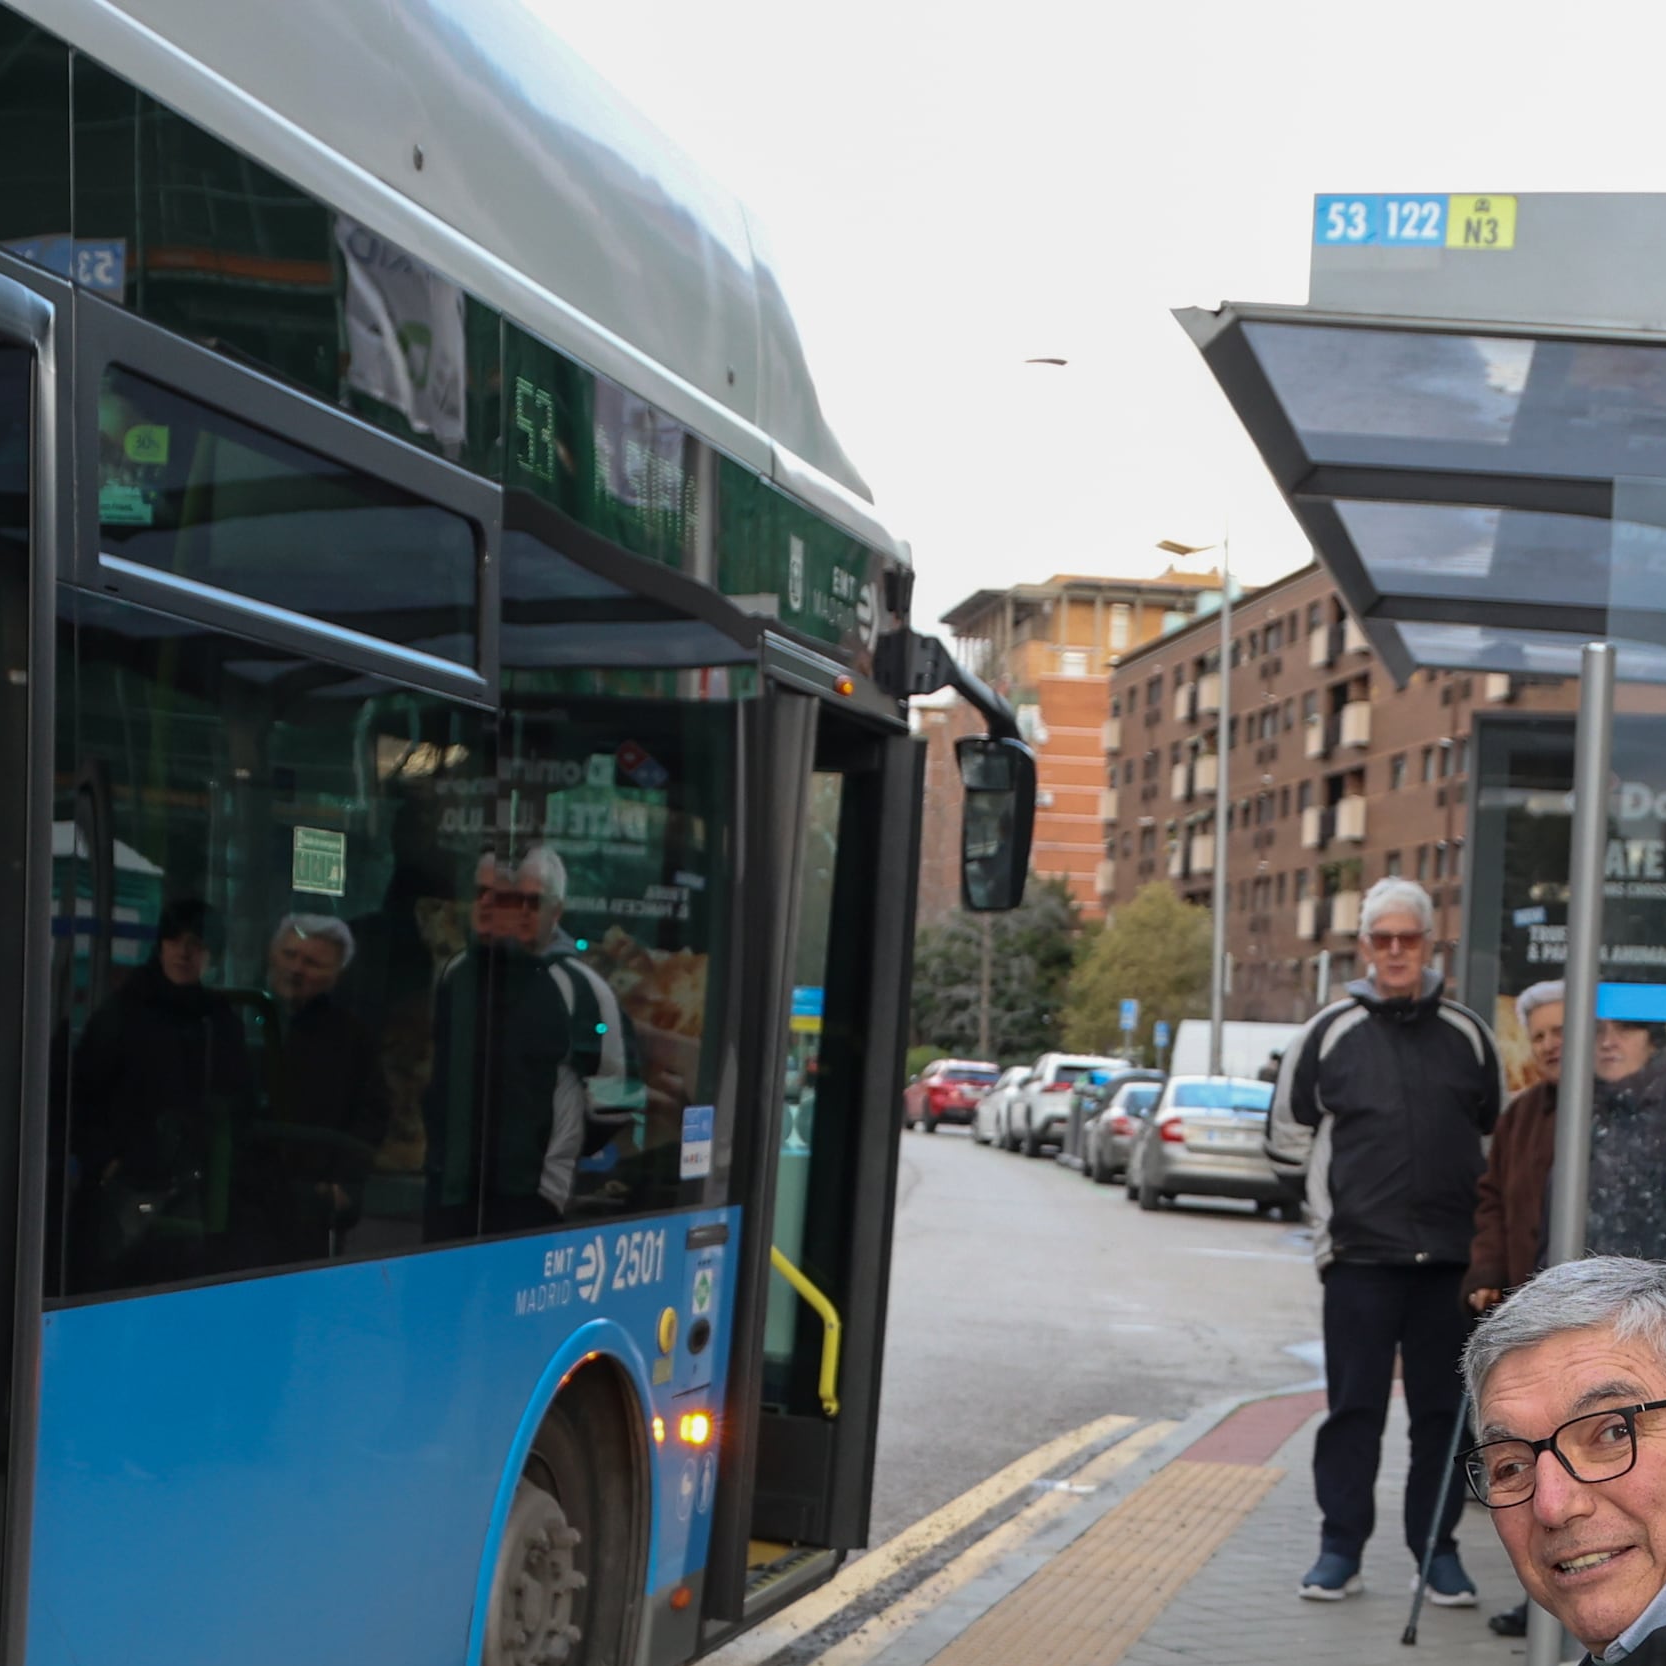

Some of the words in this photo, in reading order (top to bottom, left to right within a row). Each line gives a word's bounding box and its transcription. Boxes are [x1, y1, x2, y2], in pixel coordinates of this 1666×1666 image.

[1326, 203, 1368, 238] 53
[1386, 202, 1441, 238] 122
[1464, 217, 1499, 247] N3
[1605, 840, 1665, 879] ATE
[544, 1246, 574, 1278] EMT
[612, 1228, 666, 1292] 2501
[515, 1278, 572, 1317] MADRID
